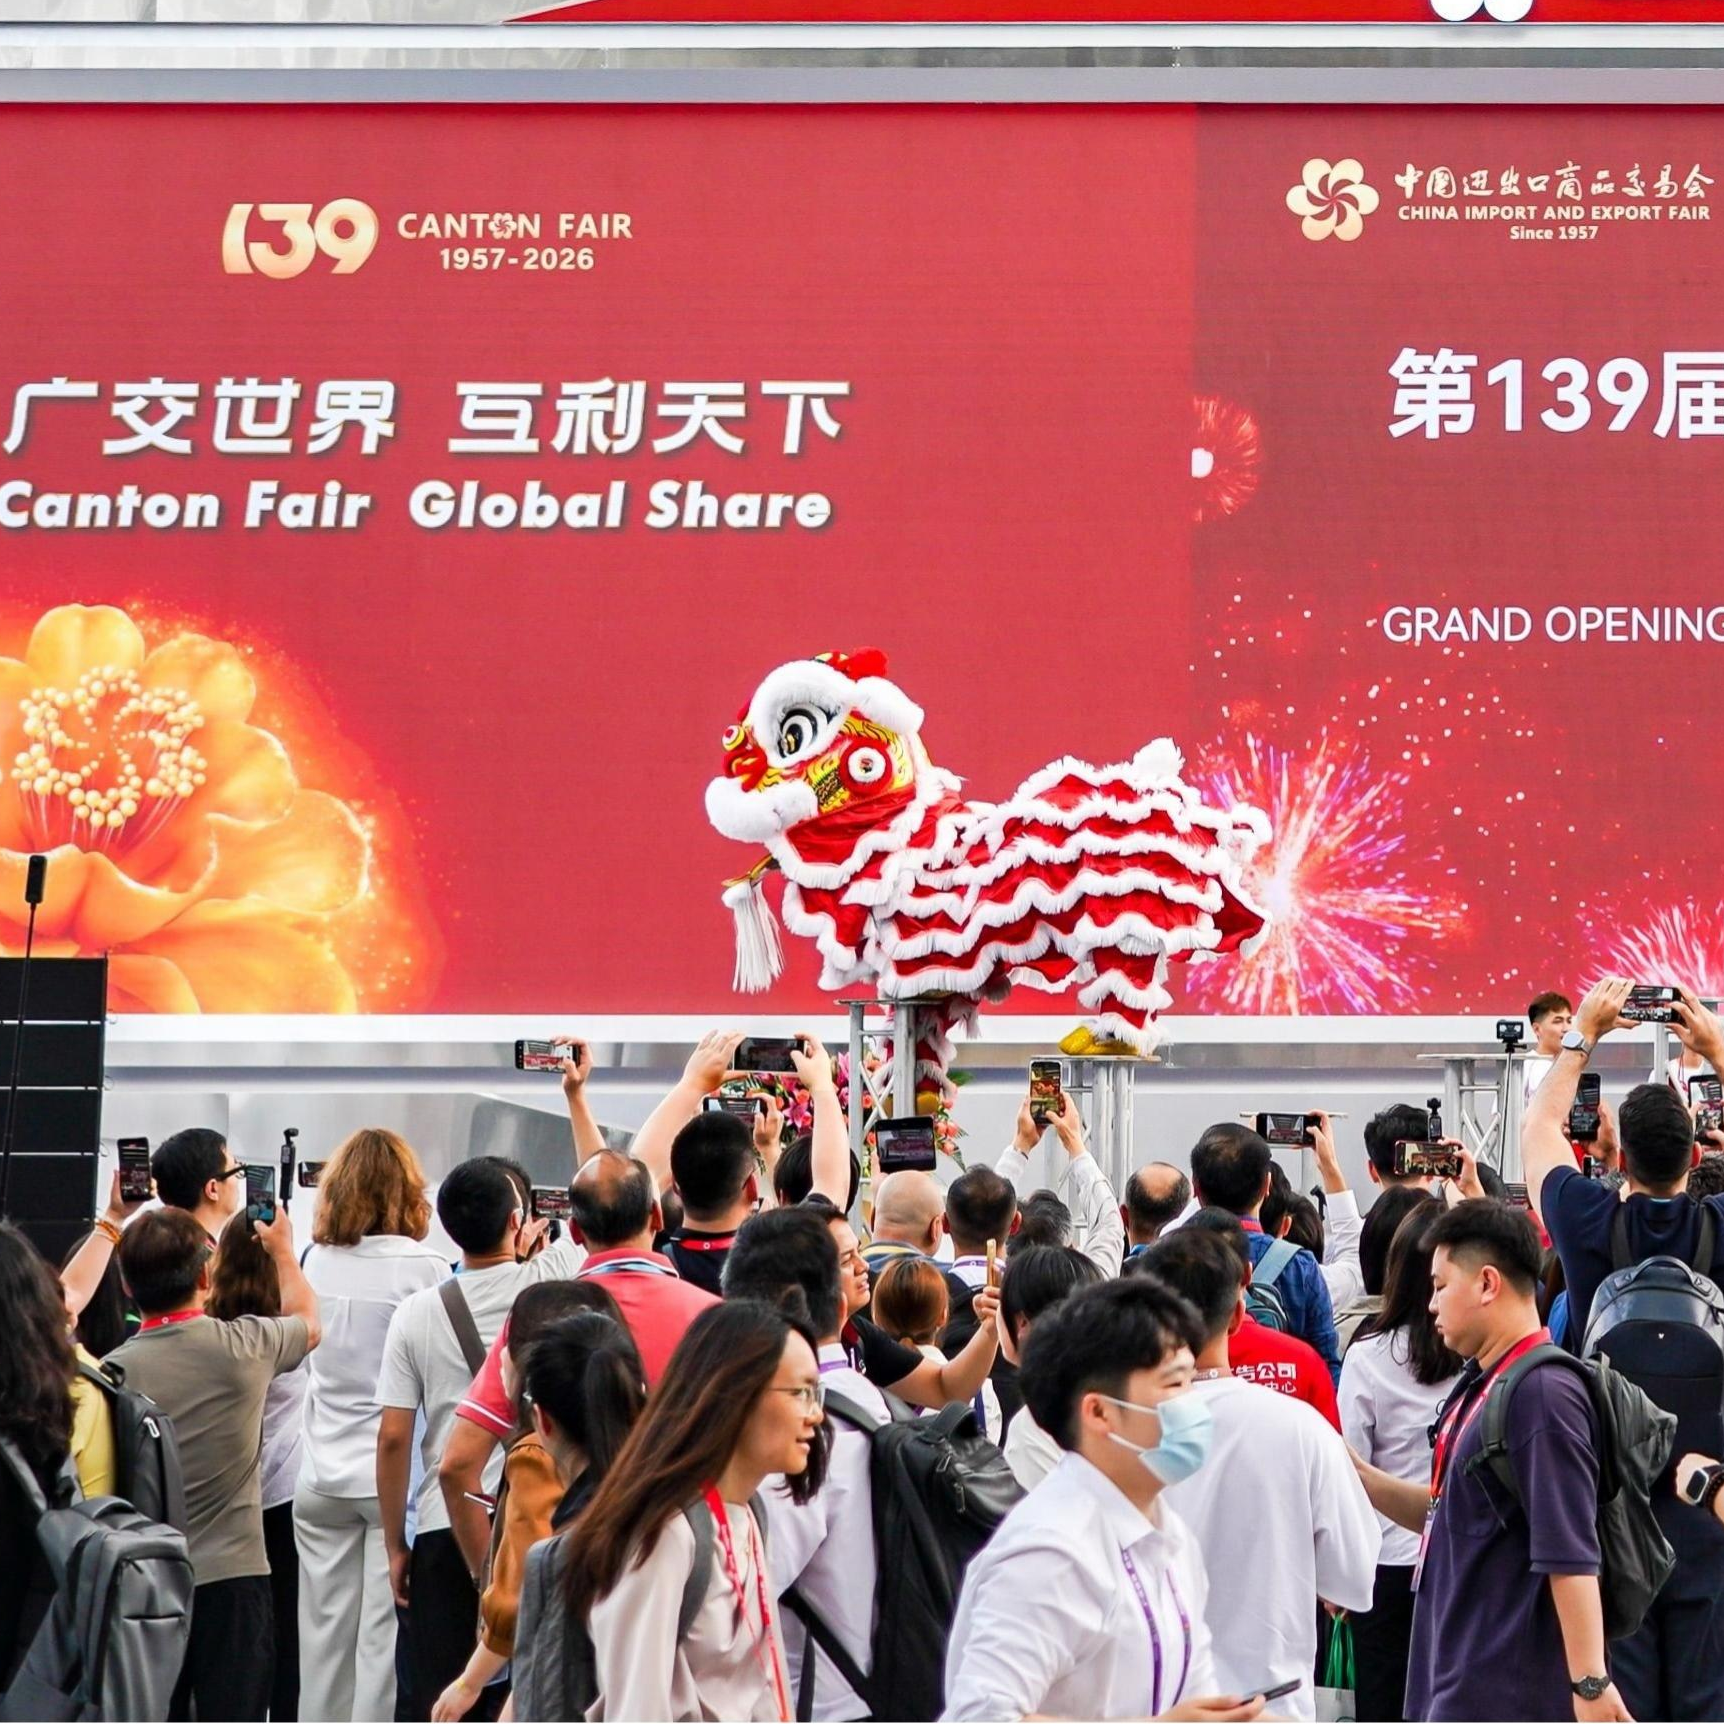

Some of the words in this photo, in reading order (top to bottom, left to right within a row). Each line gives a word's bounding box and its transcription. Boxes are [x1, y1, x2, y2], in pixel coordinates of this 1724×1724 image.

[1398, 205, 1458, 220] CHINA
[1465, 205, 1537, 220] IMPORT
[1543, 205, 1584, 220] AND
[1591, 205, 1662, 220] EXPORT
[1668, 205, 1711, 220] FAIR
[222, 198, 379, 279] 139
[559, 213, 633, 239] FAIR
[1509, 225, 1553, 240] Since
[1558, 225, 1599, 240] 1957
[440, 247, 594, 270] 1957-2026
[3, 377, 395, 455] 广交世界
[448, 377, 850, 455] 互利天下
[0, 480, 219, 528] Canton
[245, 480, 370, 528] Fair
[410, 480, 625, 528] Global
[645, 479, 830, 528] Share
[1382, 606, 1532, 642] GRAND
[1231, 1362, 1297, 1381] 告公司
